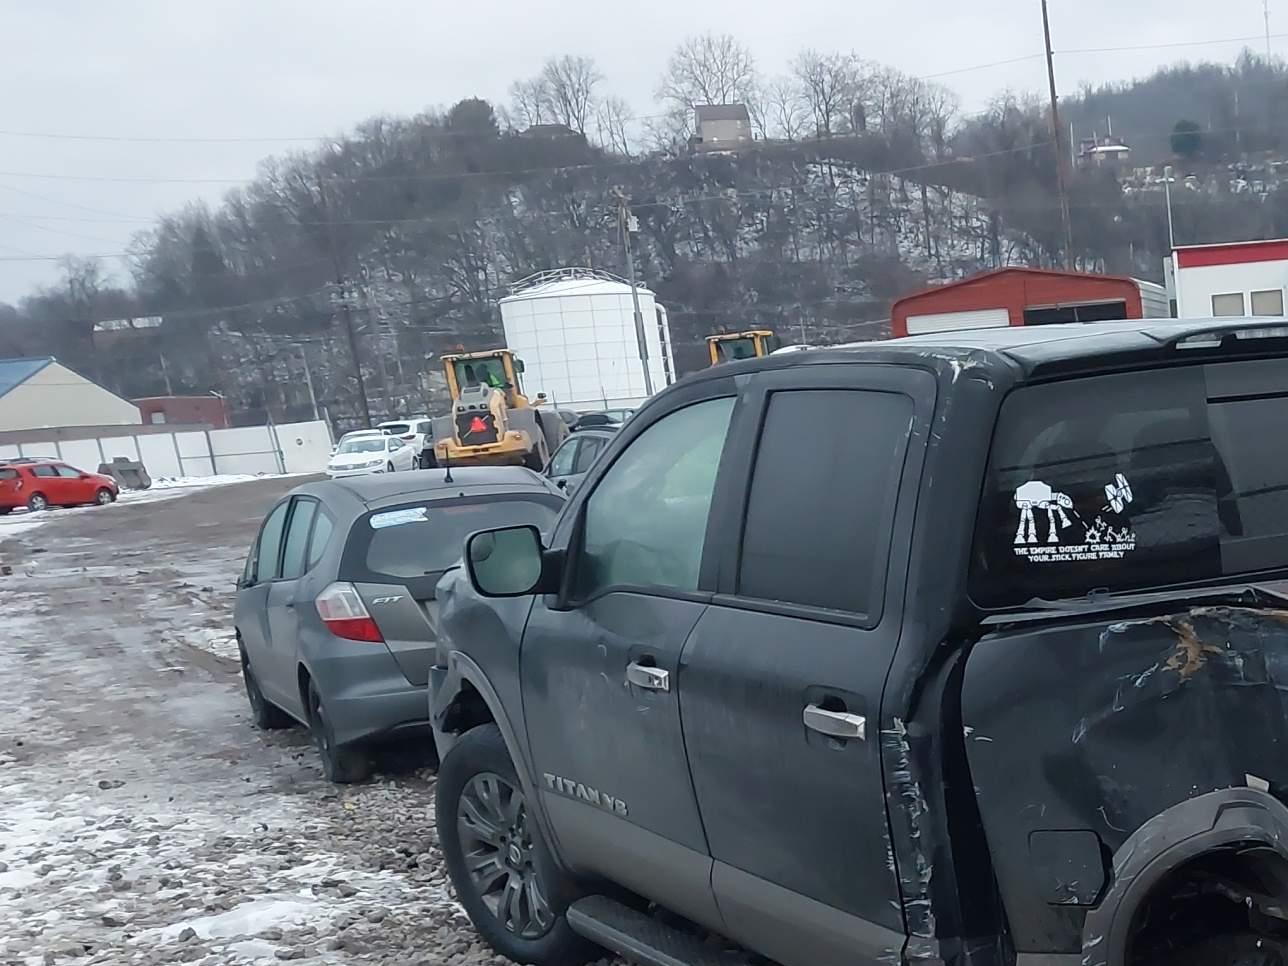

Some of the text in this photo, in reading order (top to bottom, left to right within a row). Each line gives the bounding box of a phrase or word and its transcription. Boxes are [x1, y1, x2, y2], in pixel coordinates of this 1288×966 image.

[1013, 547, 1028, 555] THE
[1029, 546, 1057, 554] EMPIRE
[1090, 543, 1110, 551] CARE
[1111, 543, 1135, 551] ABOUT
[1028, 551, 1124, 562] YOUR STICK FIGURE FAMILY
[543, 772, 600, 805] TITAN
